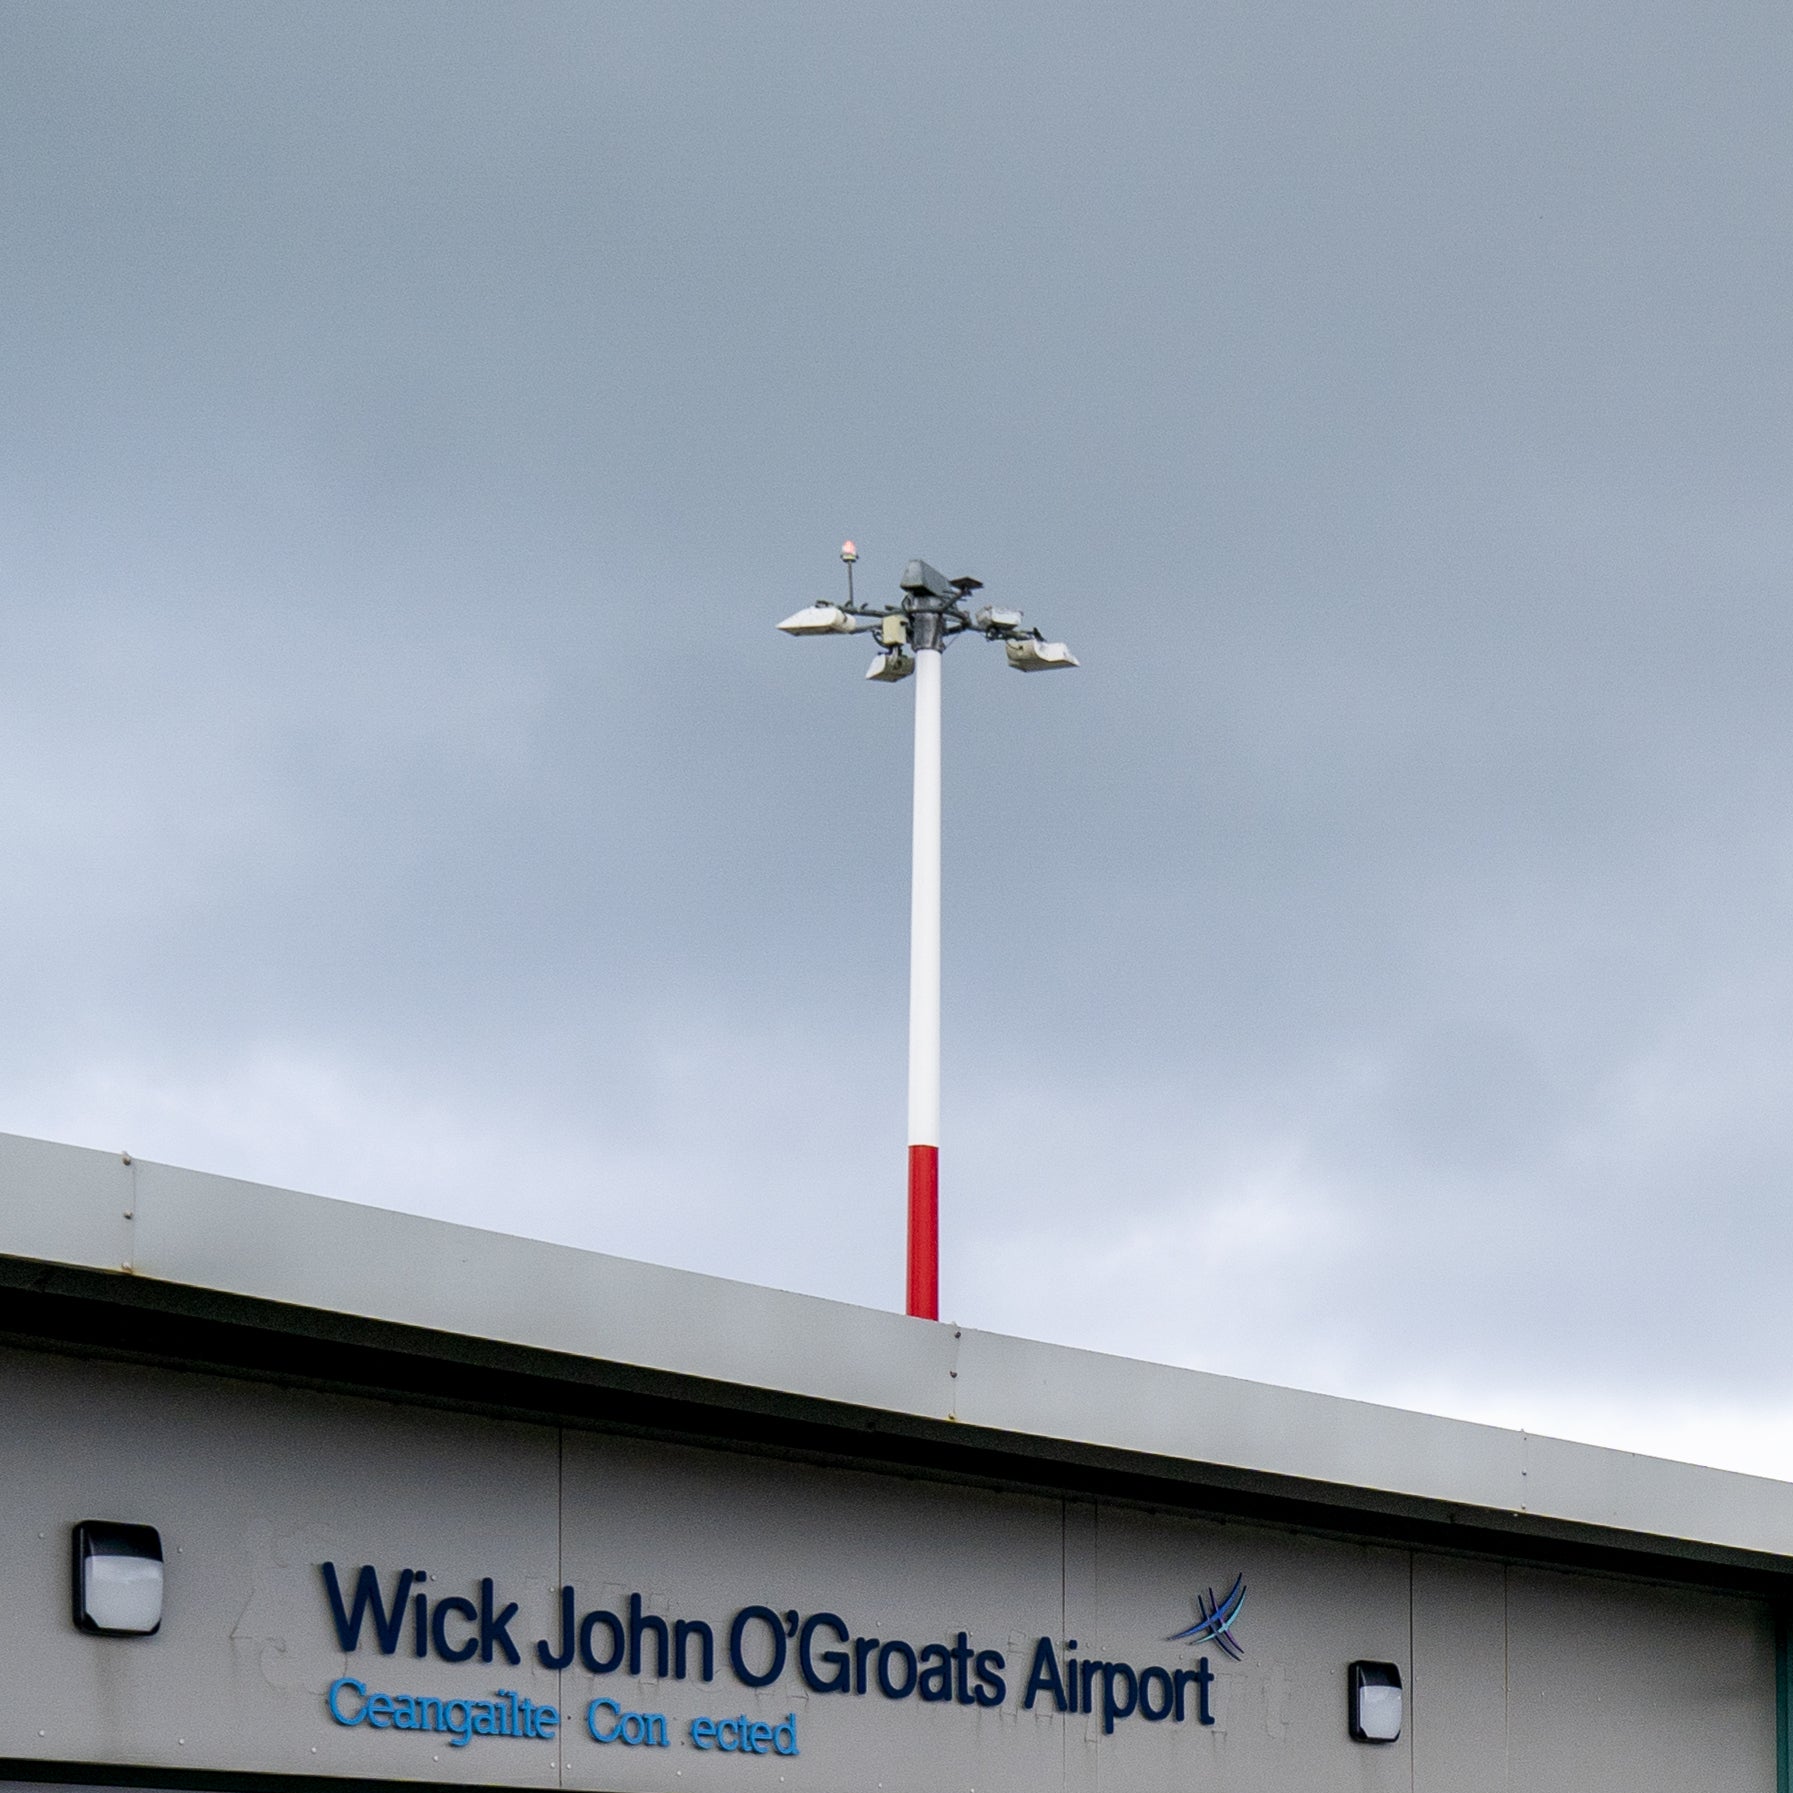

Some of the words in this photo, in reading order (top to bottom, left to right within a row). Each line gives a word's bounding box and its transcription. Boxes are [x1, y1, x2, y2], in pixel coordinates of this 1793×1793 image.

[322, 1561, 521, 1666] Wick
[537, 1585, 714, 1682] John
[730, 1604, 1006, 1708] O'Groats
[1023, 1635, 1215, 1734] Airport
[328, 1677, 560, 1747] Ceangailte
